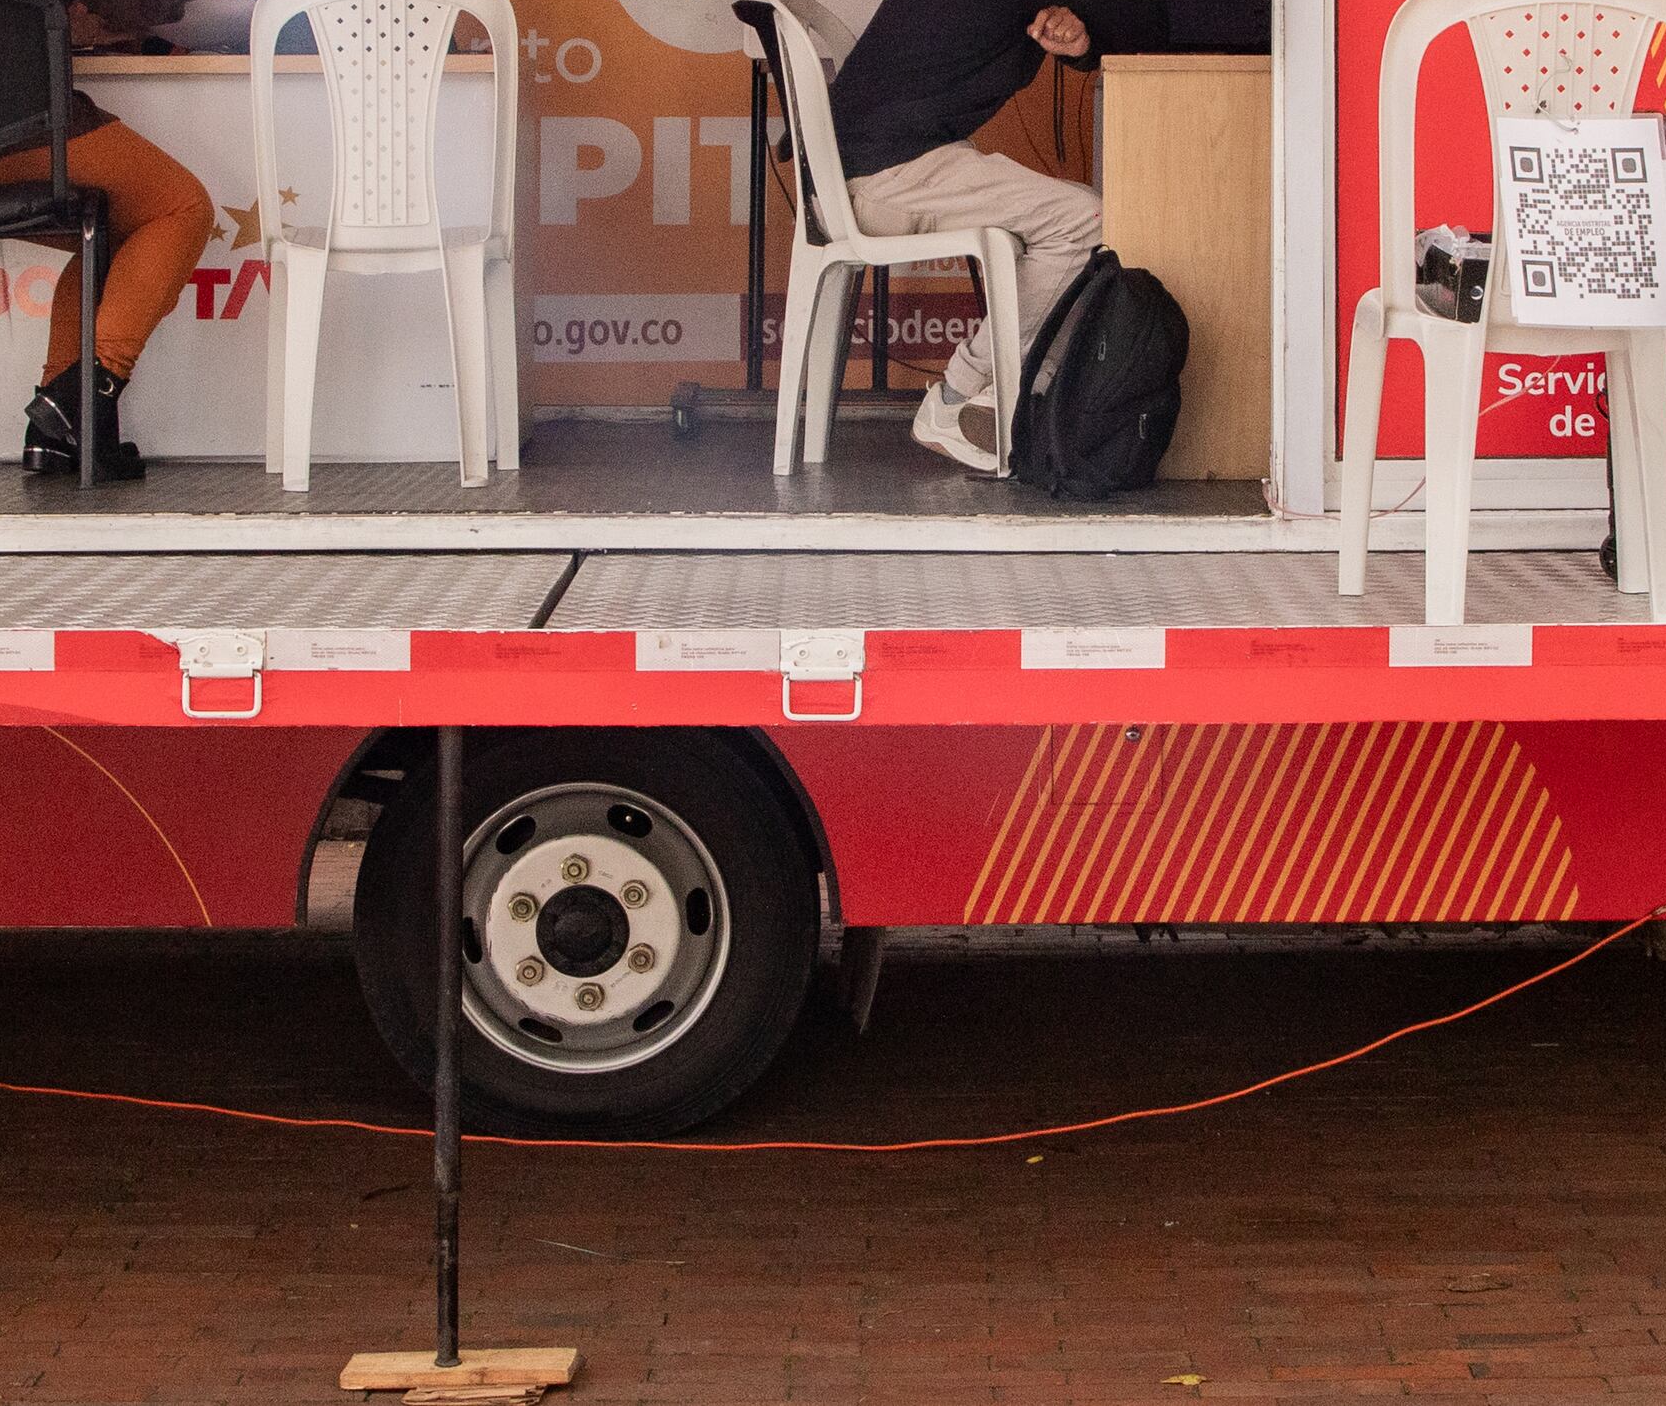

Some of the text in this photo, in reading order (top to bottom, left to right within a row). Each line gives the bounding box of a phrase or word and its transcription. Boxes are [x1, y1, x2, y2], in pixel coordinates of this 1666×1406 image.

[1575, 228, 1605, 236] EMPLEO
[533, 319, 683, 354] o.gov.co
[1549, 405, 1596, 437] de
